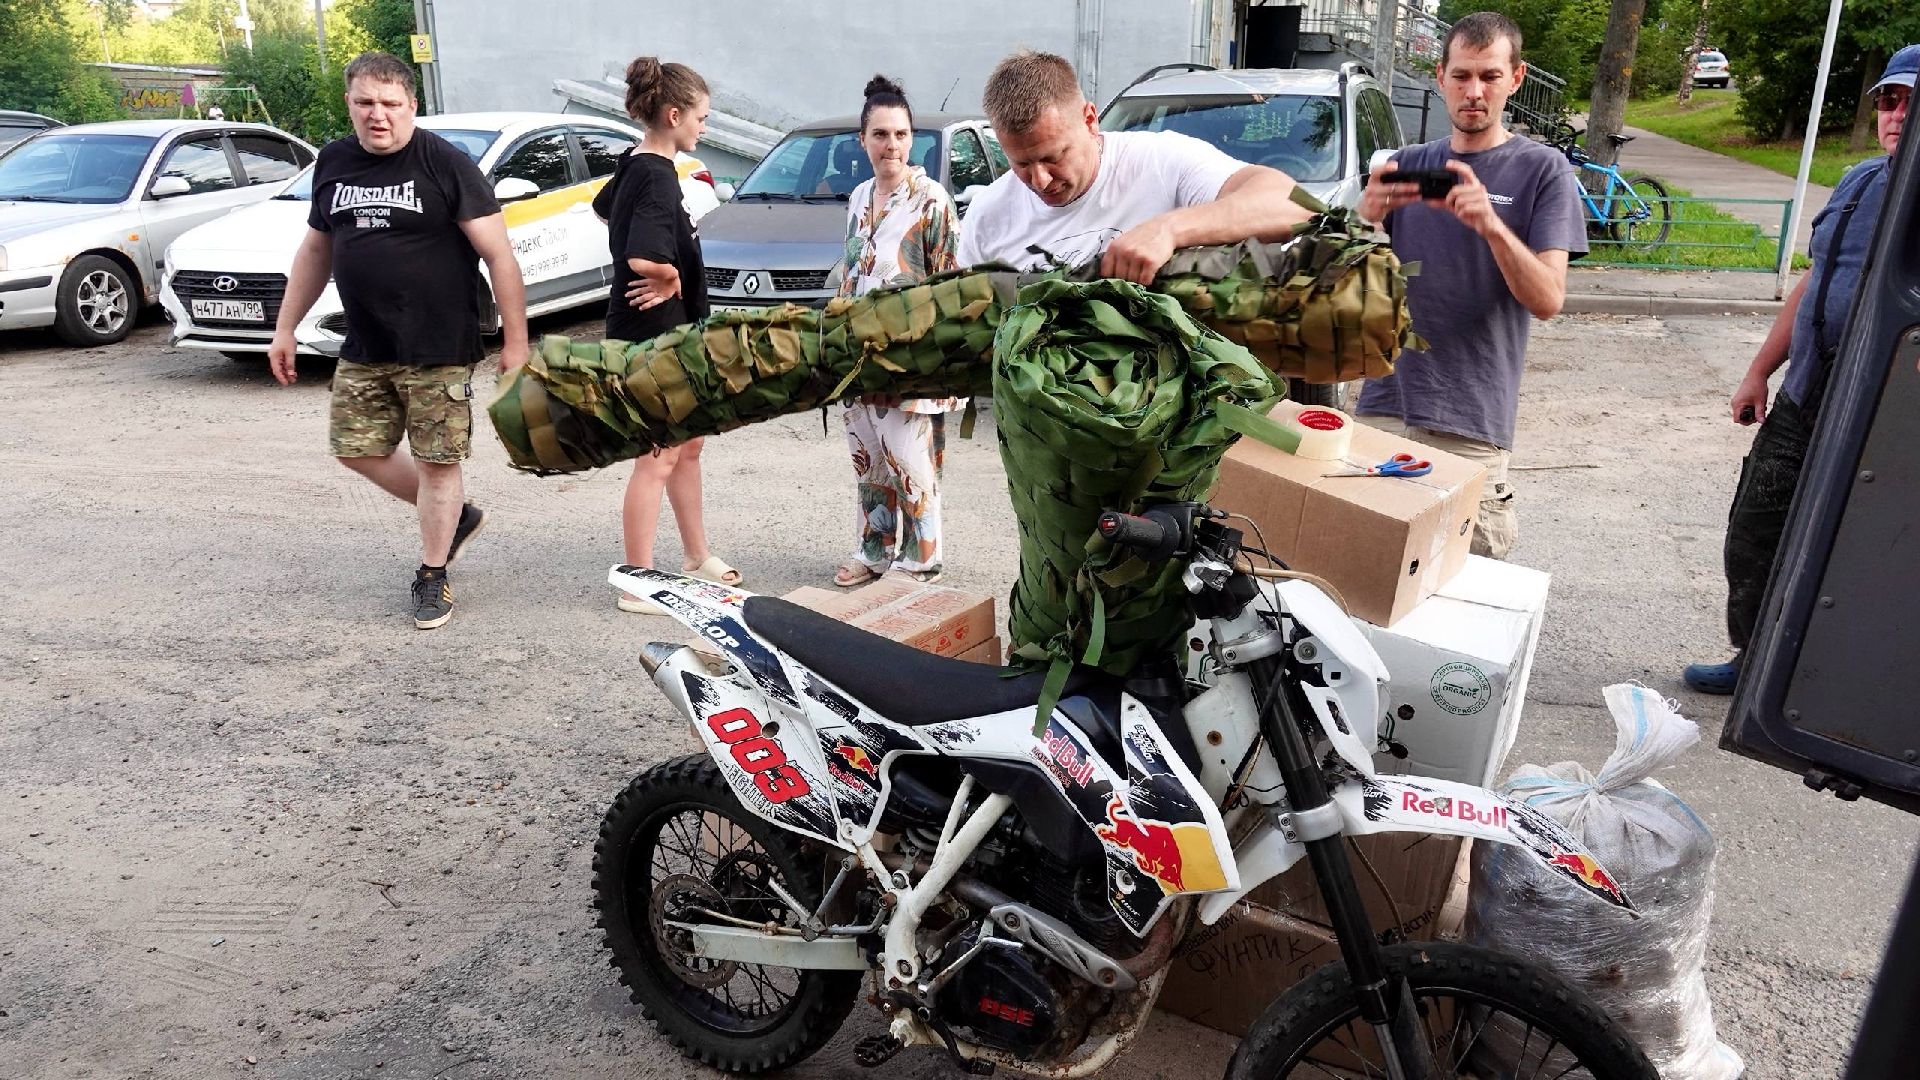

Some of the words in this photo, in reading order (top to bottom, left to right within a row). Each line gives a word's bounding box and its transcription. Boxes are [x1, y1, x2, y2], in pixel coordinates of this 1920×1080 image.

[330, 181, 423, 214] LONSDALE
[353, 208, 391, 217] LONDON
[659, 593, 740, 648] DUNLOP
[1442, 685, 1477, 698] ORGANIC
[707, 707, 810, 804] 003
[1031, 745, 1072, 789] MOTOCROSS
[1032, 726, 1069, 757] ed
[1056, 741, 1095, 789] Bull
[1402, 791, 1453, 817] Red
[1458, 800, 1507, 828] Bull
[1186, 934, 1304, 981] ФУНТИК
